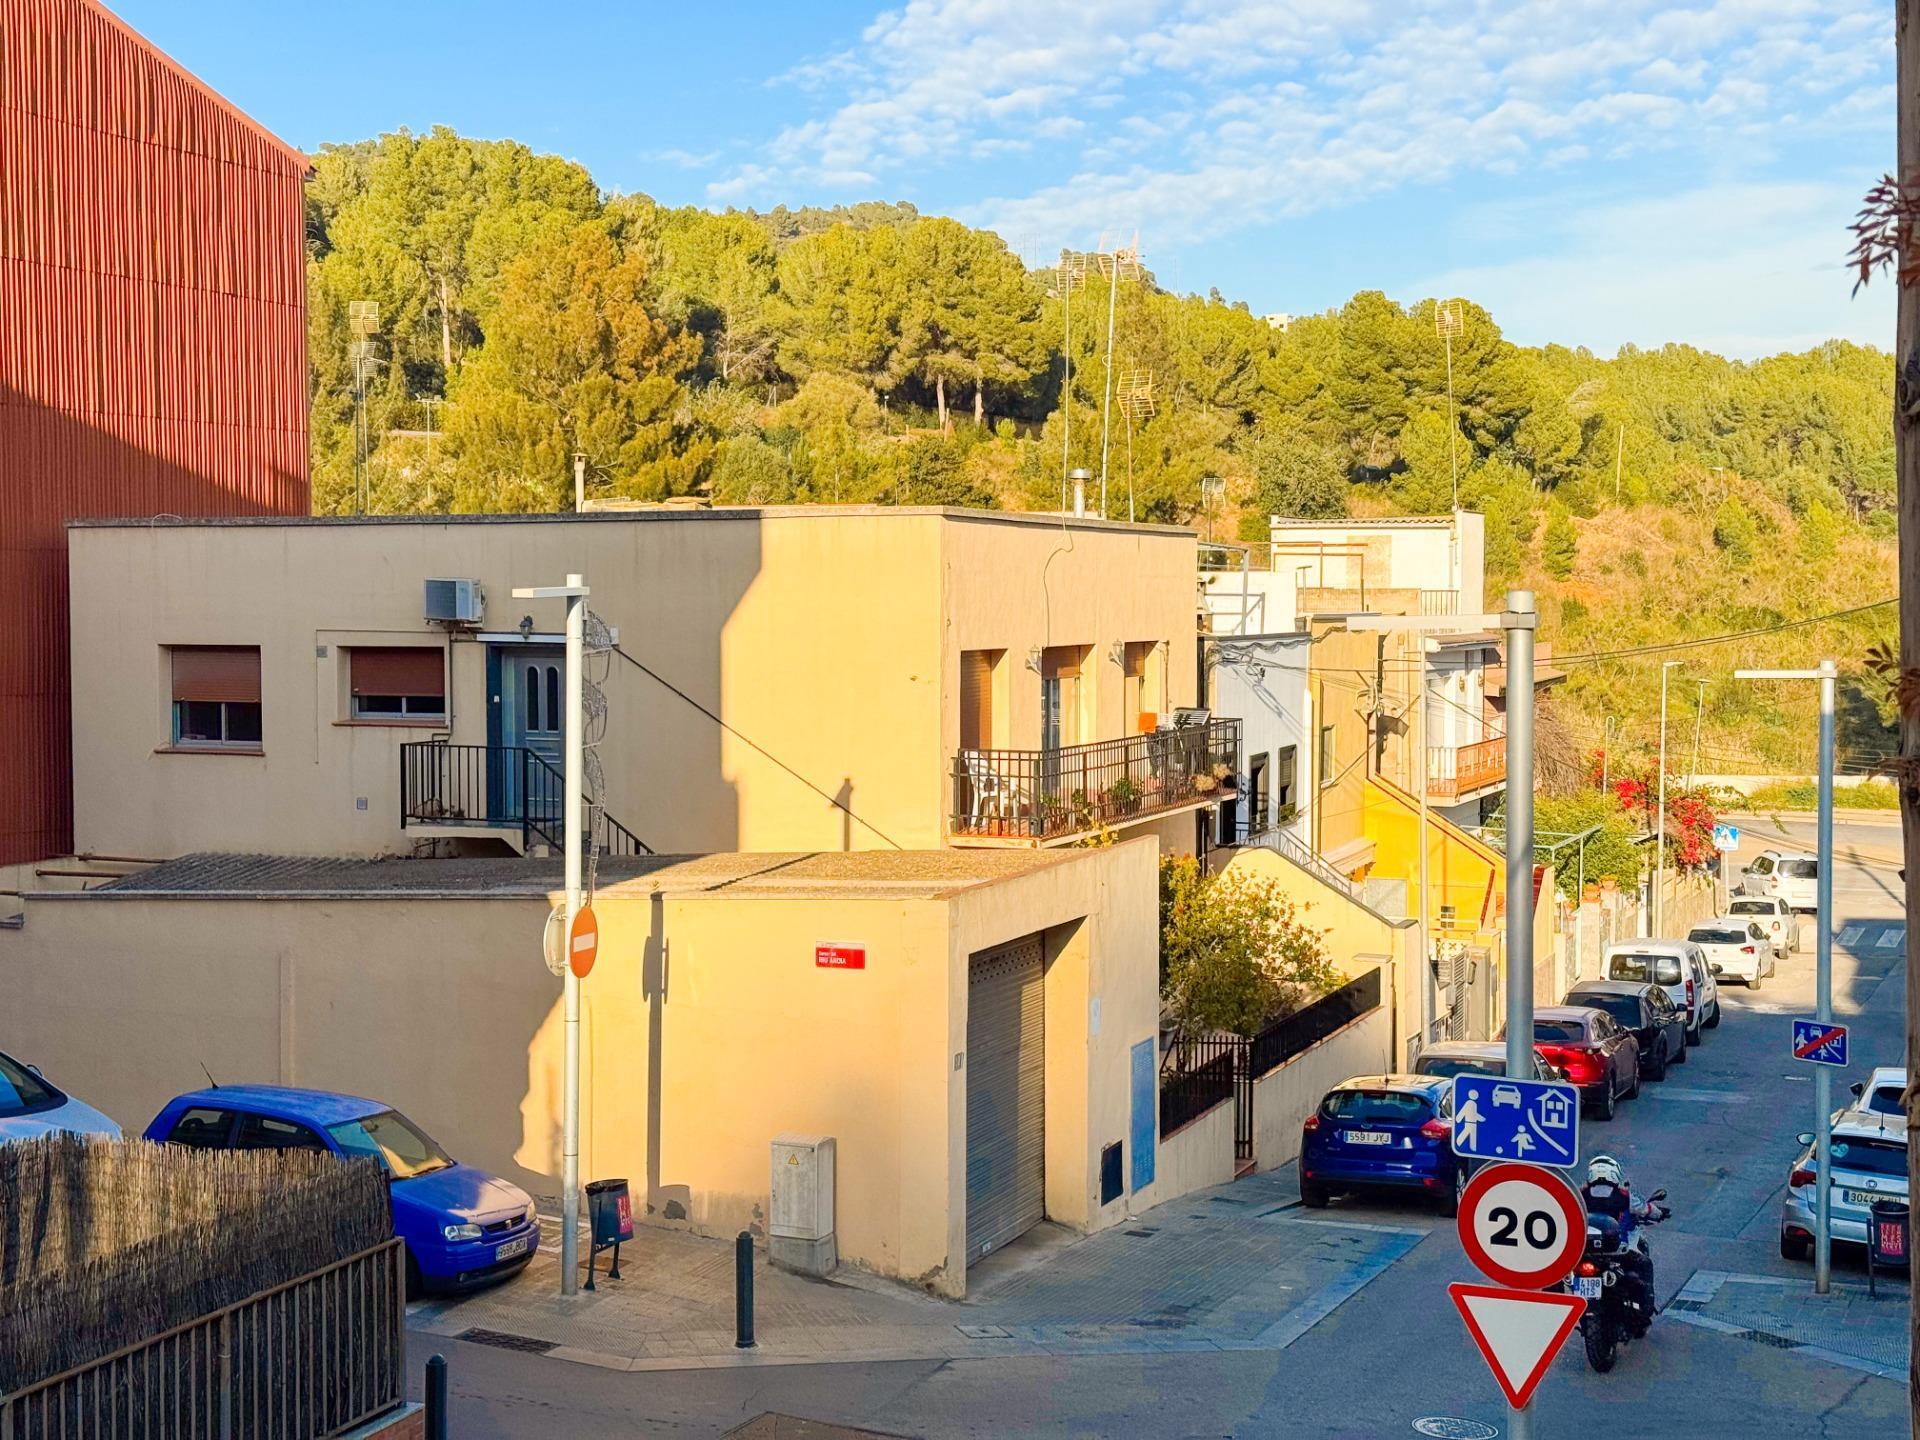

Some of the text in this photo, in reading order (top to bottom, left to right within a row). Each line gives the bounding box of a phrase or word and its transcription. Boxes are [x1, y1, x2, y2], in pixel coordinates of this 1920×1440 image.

[1349, 1132, 1390, 1143] 5591 JYJ
[1850, 1192, 1875, 1204] 3044
[1488, 1206, 1557, 1250] 20
[1580, 1288, 1596, 1296] HTS
